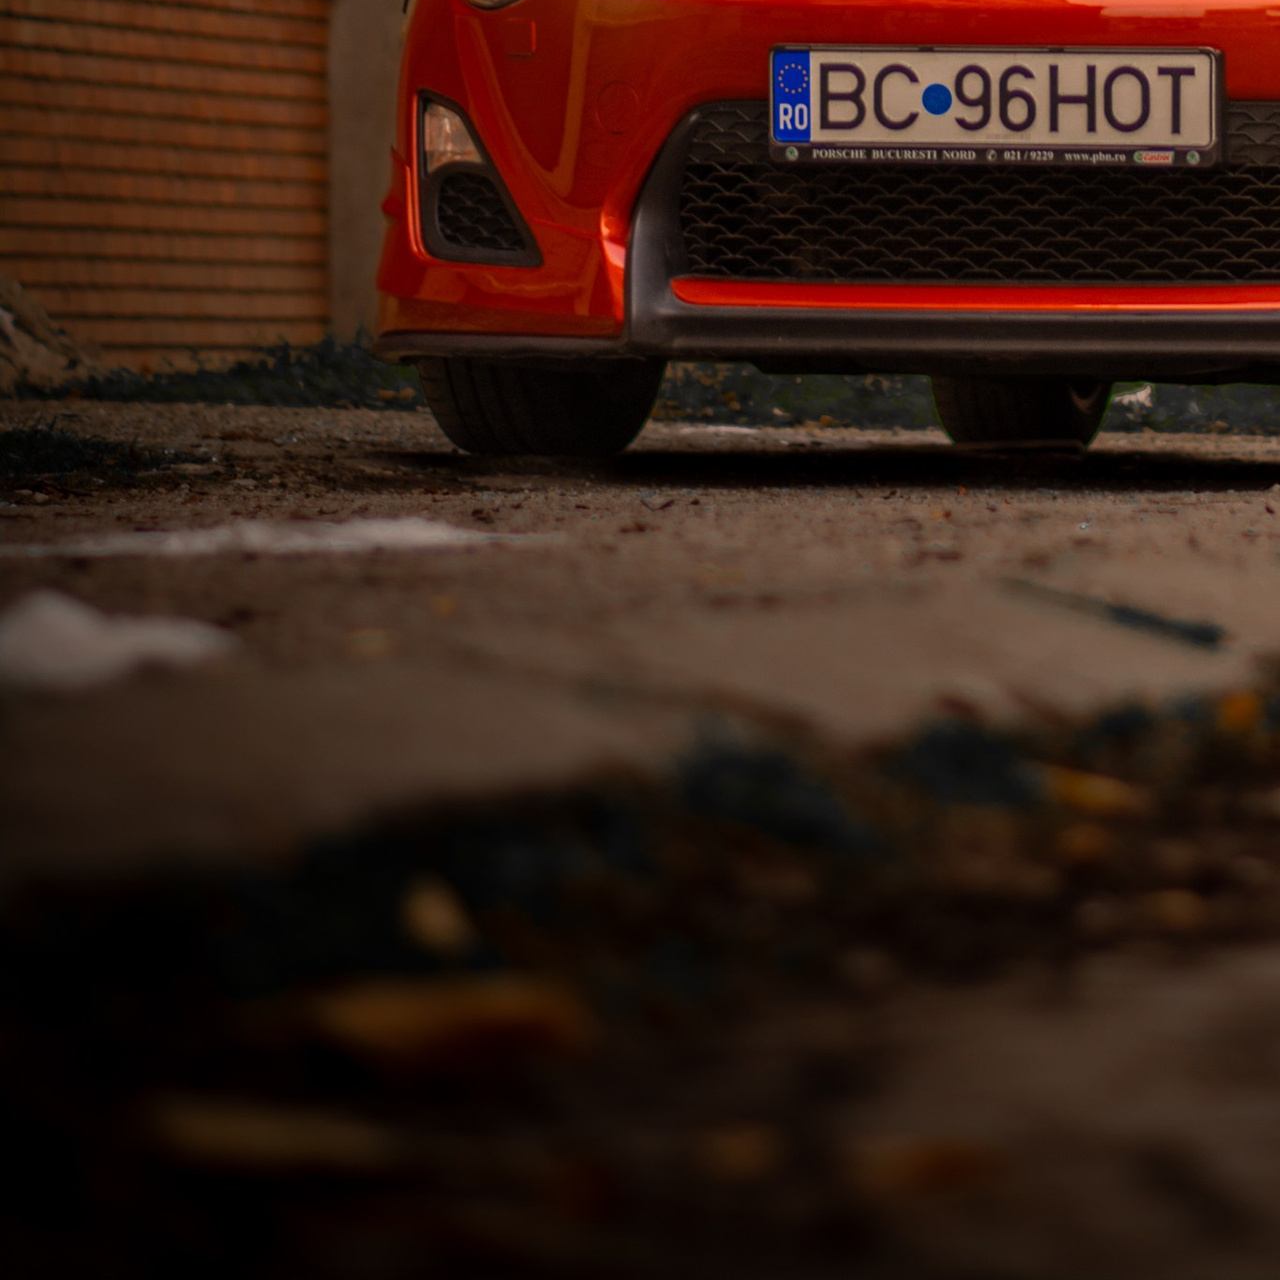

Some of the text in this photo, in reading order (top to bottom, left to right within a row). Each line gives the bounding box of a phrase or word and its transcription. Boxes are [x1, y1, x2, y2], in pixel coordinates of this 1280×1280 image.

[779, 103, 808, 130] RO
[812, 148, 867, 159] PORSCHE
[871, 148, 938, 160] BUCURESTI
[942, 149, 977, 160] NORD
[1003, 149, 1021, 161] 021
[1030, 150, 1055, 161] 9229
[1064, 150, 1126, 164] www.pbn.ro
